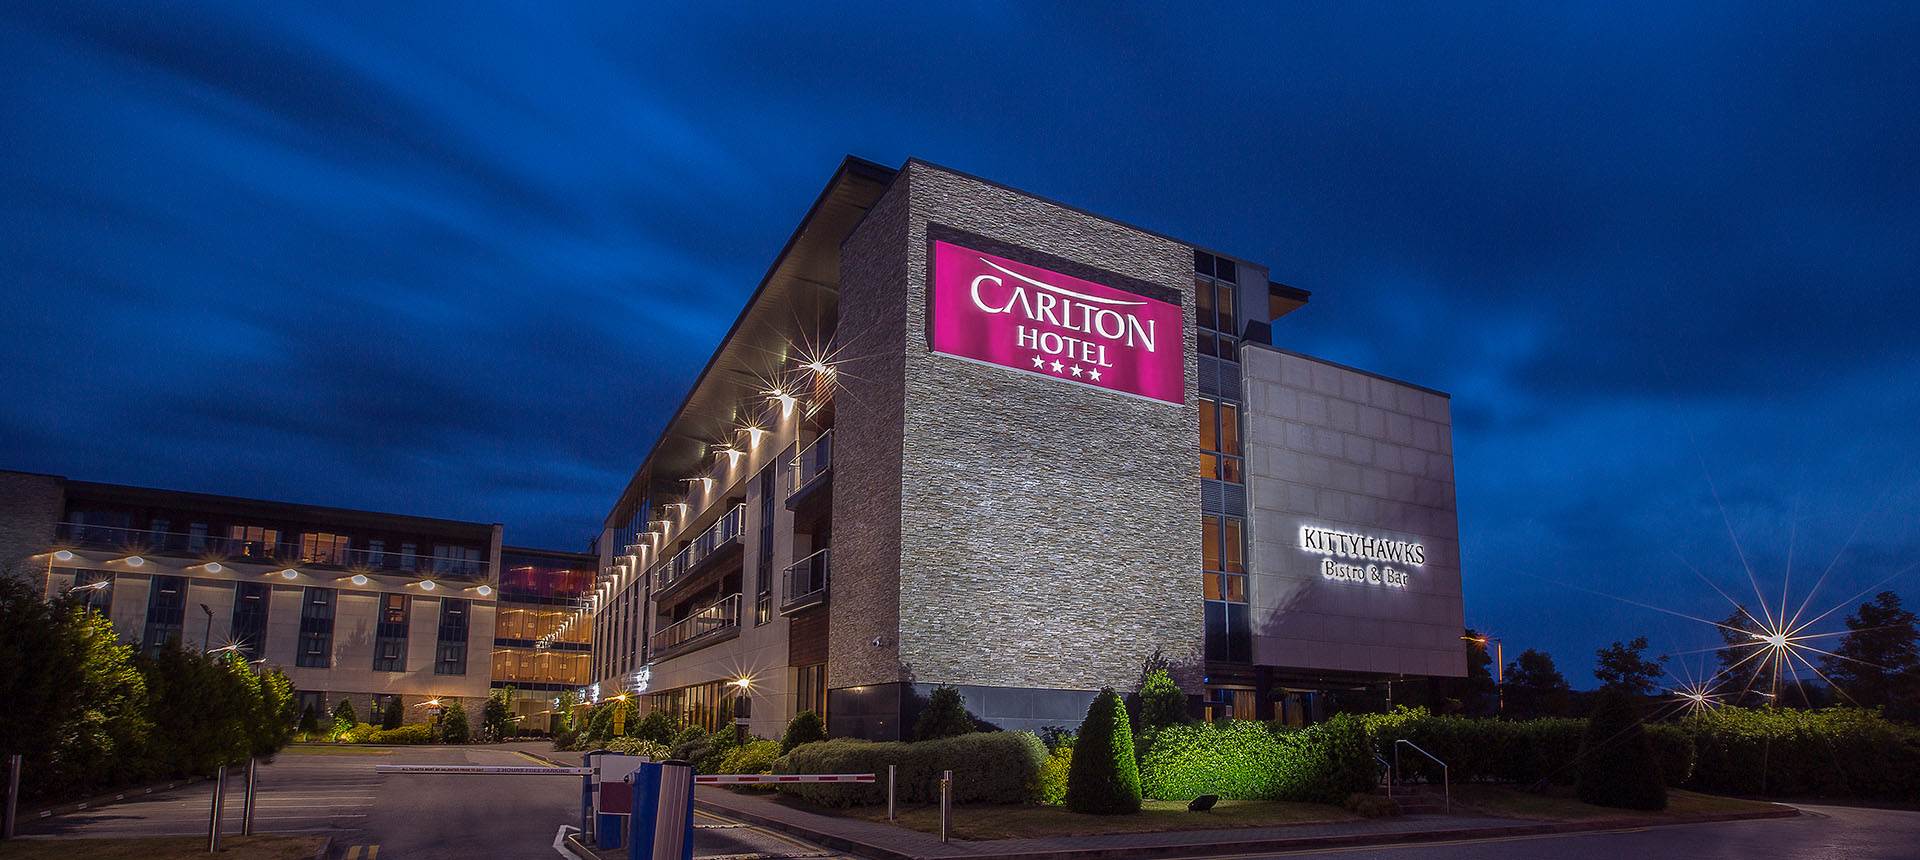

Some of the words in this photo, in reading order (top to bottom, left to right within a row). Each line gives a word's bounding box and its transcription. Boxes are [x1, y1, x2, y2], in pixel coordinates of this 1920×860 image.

[970, 274, 1156, 353] CARLTON
[1016, 325, 1113, 368] HOTEL
[1304, 528, 1425, 565] KITTYHAWKS
[1325, 560, 1365, 580] Bistro
[1371, 566, 1381, 582] &
[1387, 568, 1408, 586] Bar
